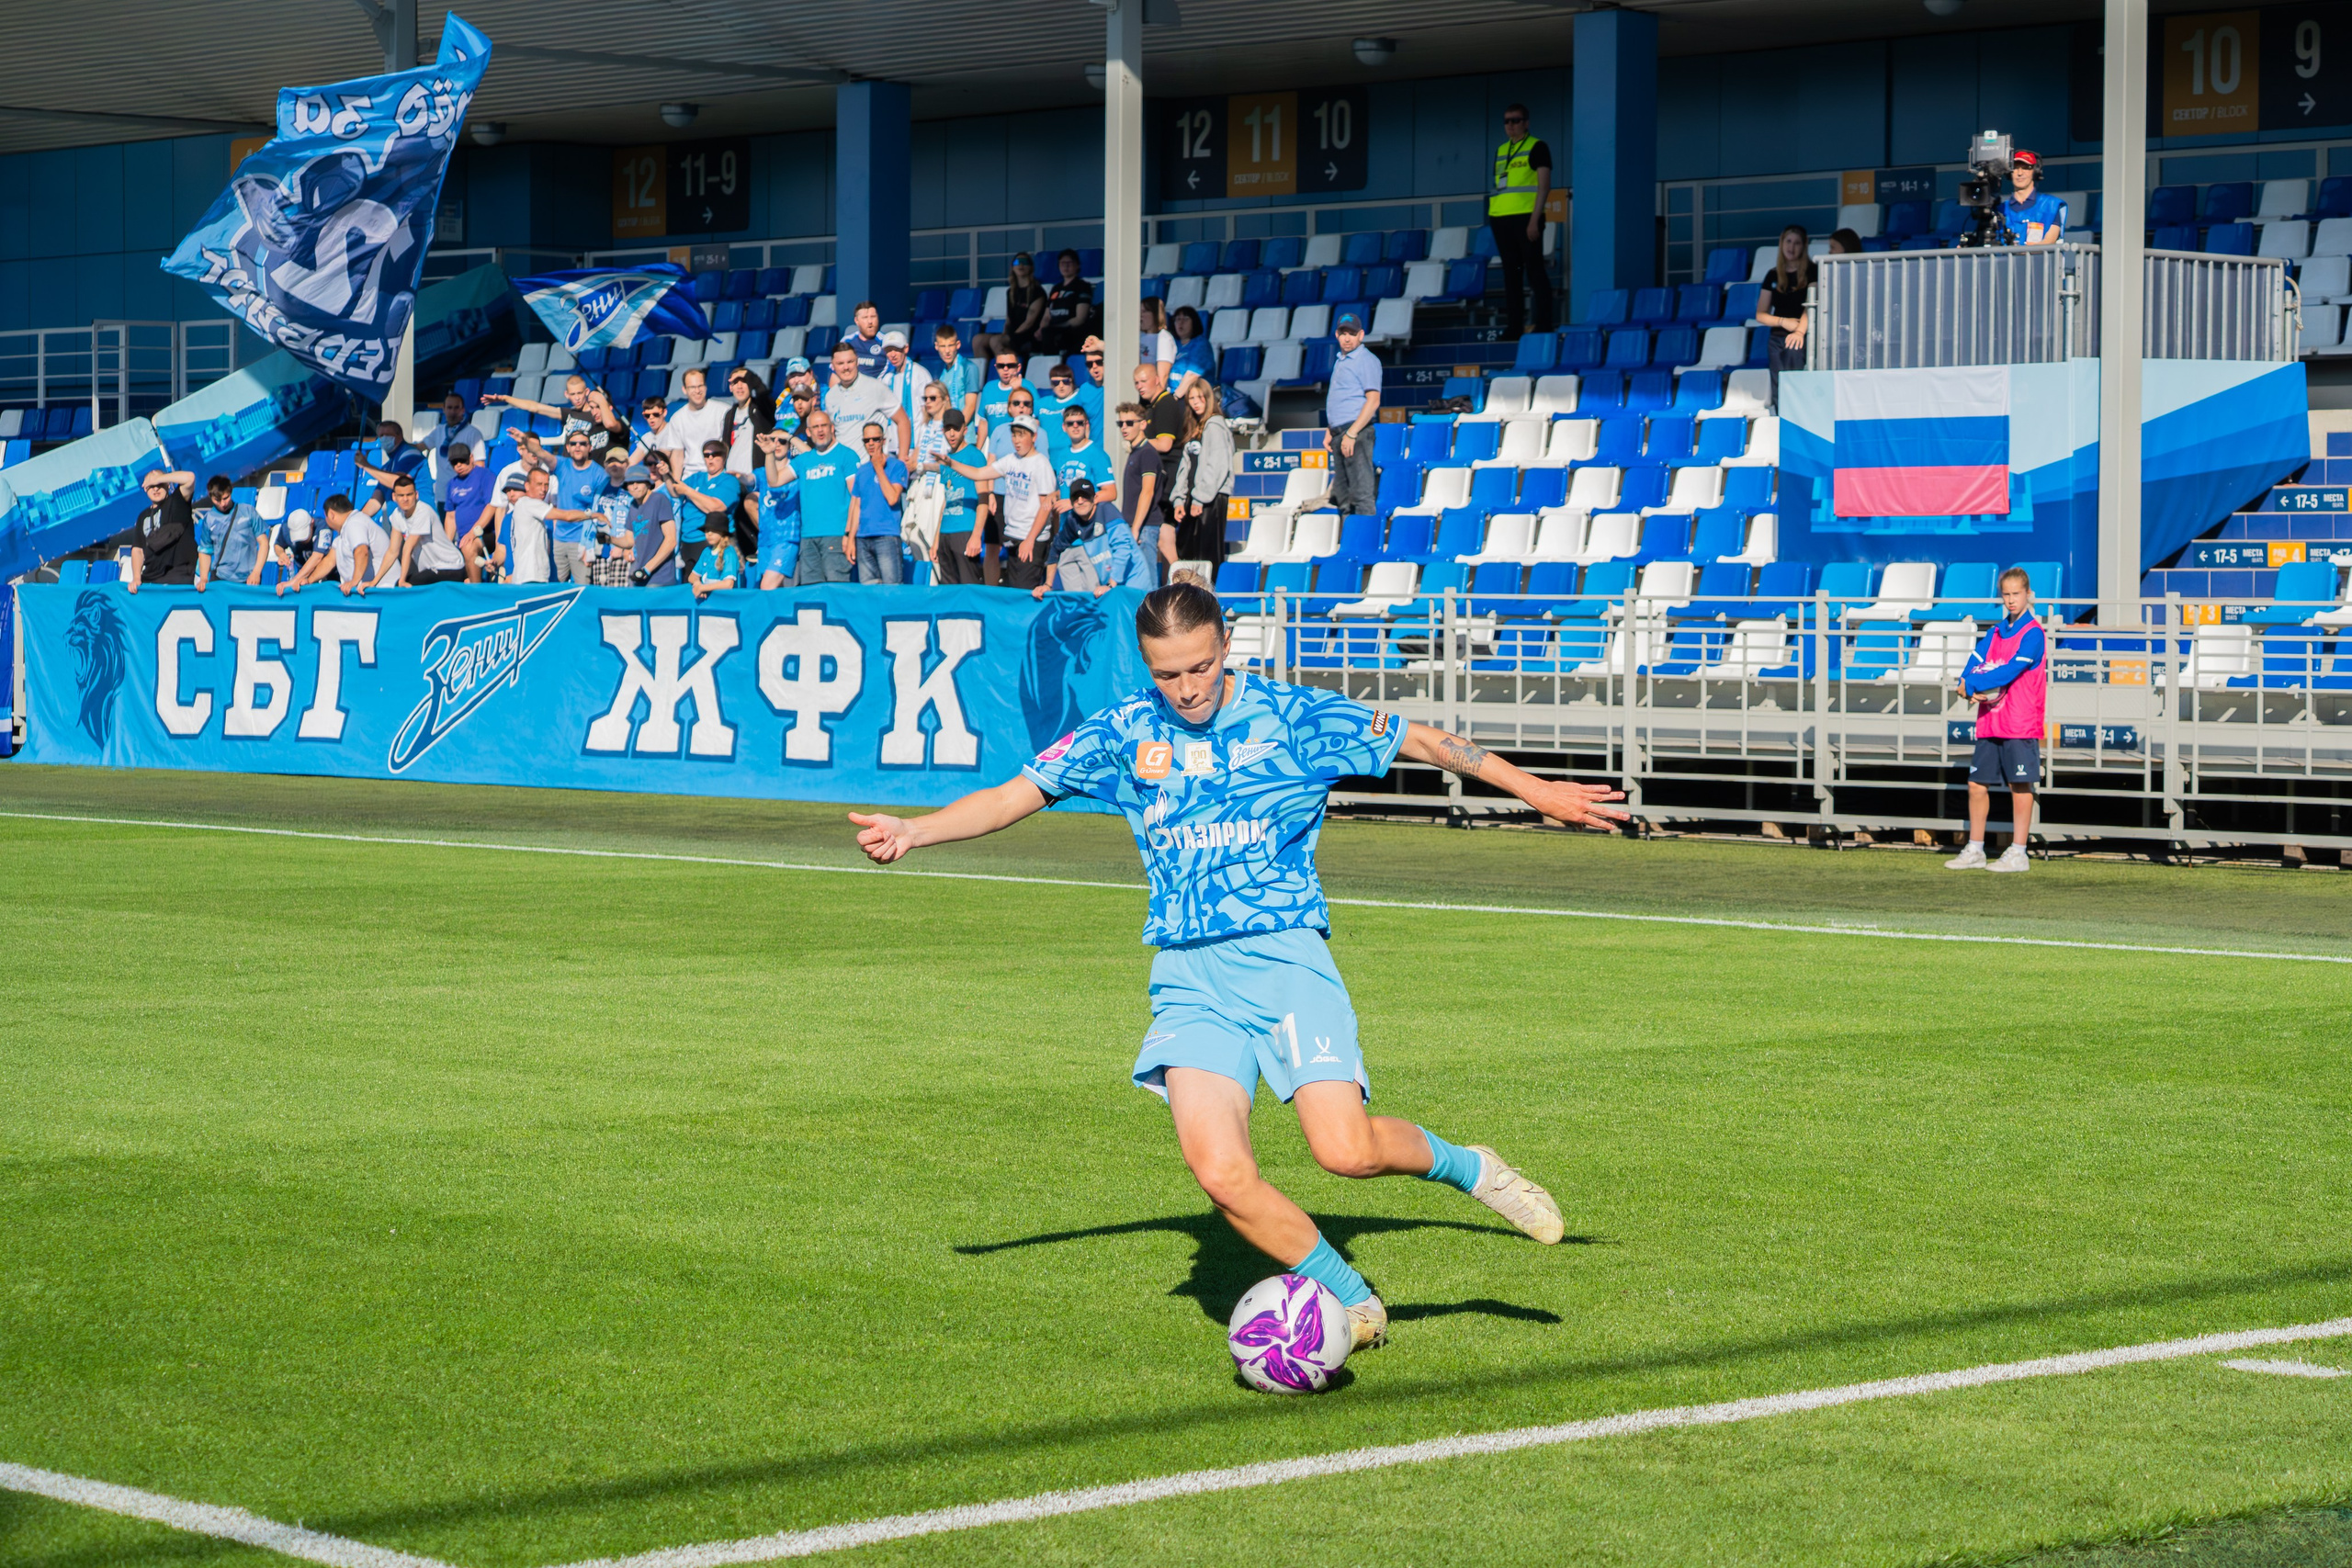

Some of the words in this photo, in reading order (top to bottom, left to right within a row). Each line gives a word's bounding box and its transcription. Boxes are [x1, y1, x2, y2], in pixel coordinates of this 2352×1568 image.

[2181, 26, 2242, 96] 10
[2294, 19, 2322, 79] 9
[1176, 108, 1212, 159] 12
[1244, 104, 1282, 164] 11
[1313, 98, 1351, 150] 10
[622, 156, 657, 209] 12
[680, 150, 736, 198] 11-9
[2294, 493, 2319, 509] 17-5
[2213, 548, 2238, 564] 17-5
[153, 604, 382, 743] СБГ
[388, 586, 585, 774] Зенит
[581, 602, 986, 773] ЖФК
[2064, 728, 2086, 739] МЕСТА
[1171, 818, 1270, 850] ГАЗПРОМ
[1309, 1055, 1342, 1064] JÖGEL
